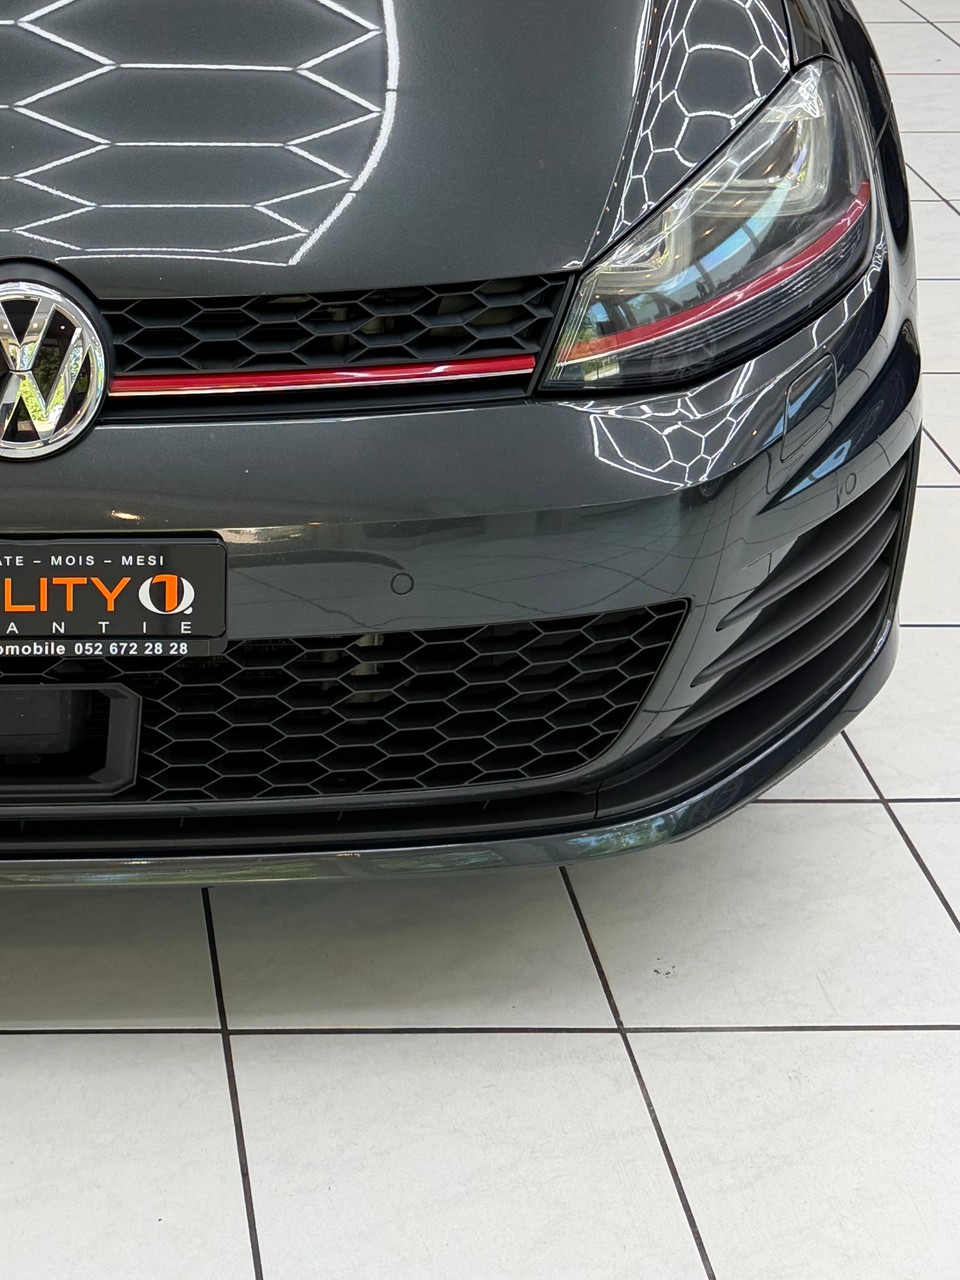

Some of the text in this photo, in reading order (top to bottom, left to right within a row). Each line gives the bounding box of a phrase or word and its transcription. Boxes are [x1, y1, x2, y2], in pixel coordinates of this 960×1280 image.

[50, 555, 96, 566] MOIS
[121, 554, 165, 566] MESI
[74, 642, 103, 655] 052
[109, 642, 138, 655] 672
[144, 642, 163, 655] 28
[169, 642, 188, 655] 28
